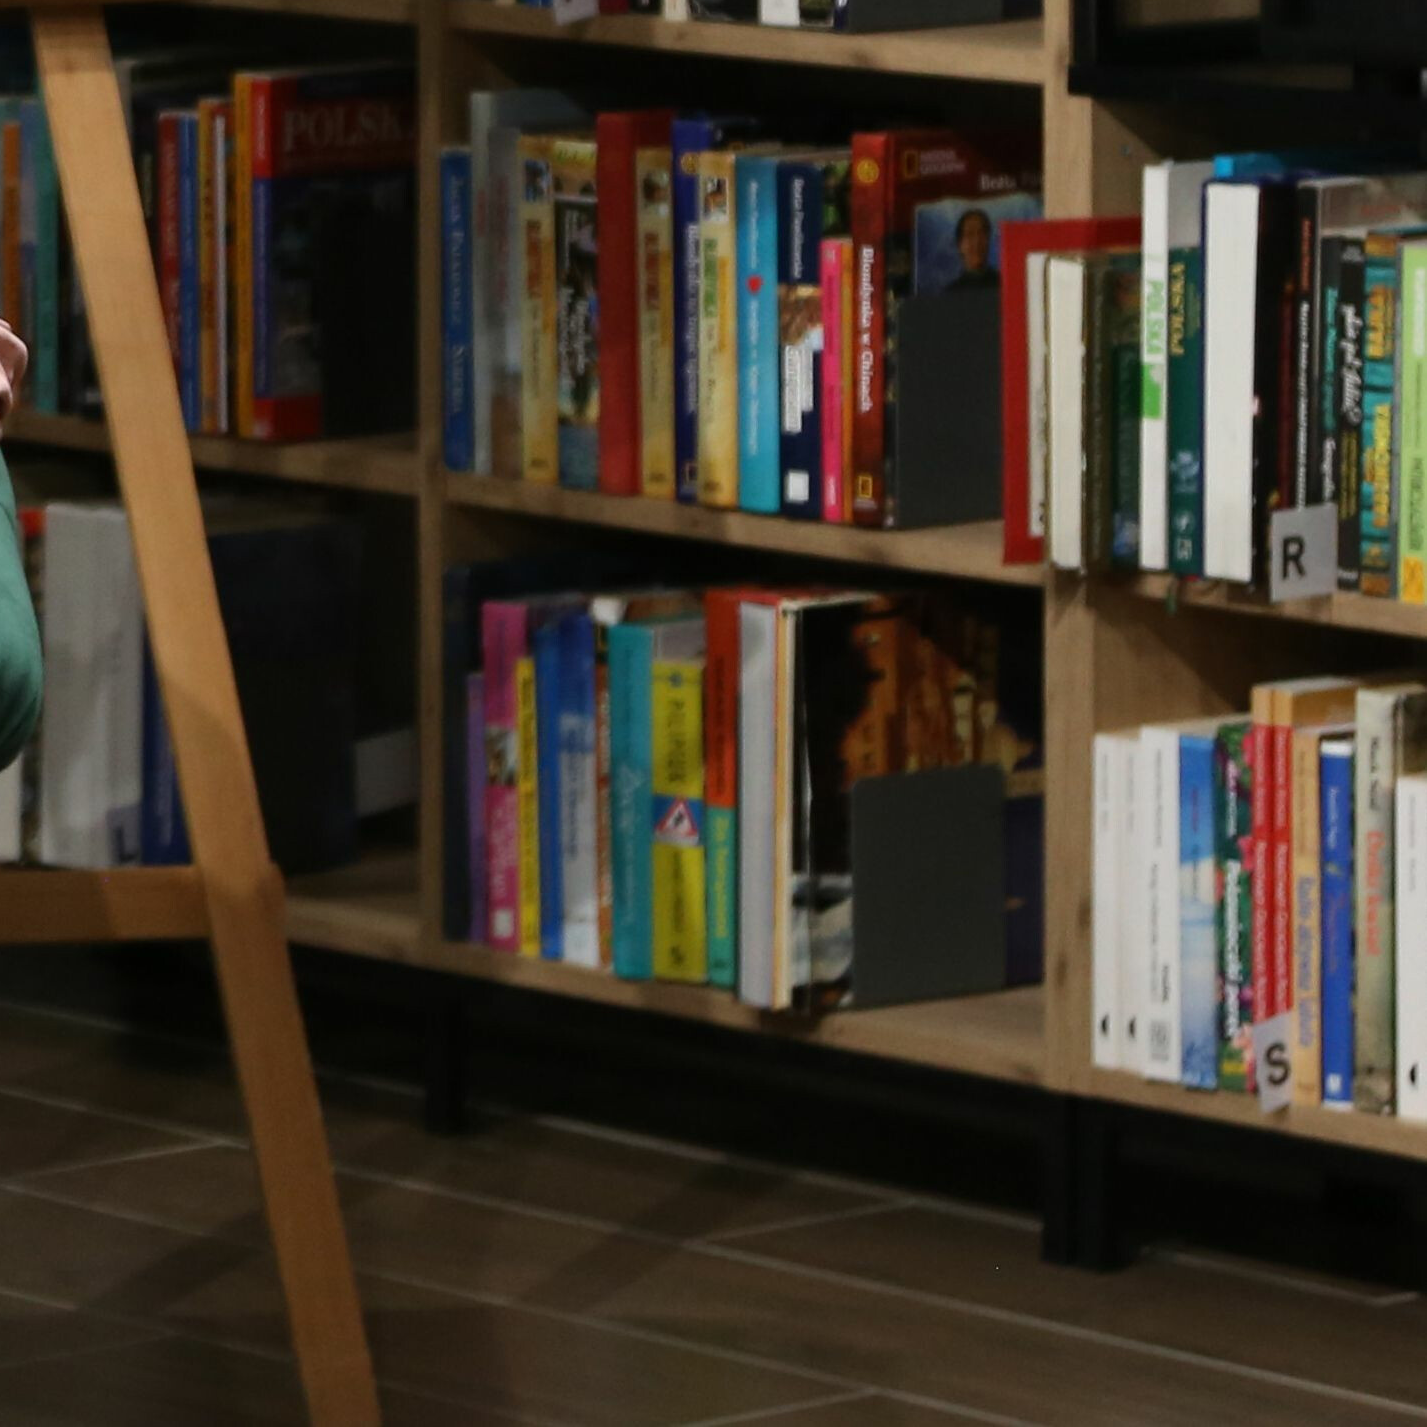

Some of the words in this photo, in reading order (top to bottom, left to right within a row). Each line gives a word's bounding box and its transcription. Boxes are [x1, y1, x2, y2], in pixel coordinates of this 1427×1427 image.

[857, 244, 875, 328] Blondynka
[1146, 278, 1164, 355] POLSKA
[1169, 261, 1187, 357] POLSKA
[857, 349, 875, 413] Chinach
[1283, 536, 1305, 581] R
[1266, 1043, 1290, 1085] S
